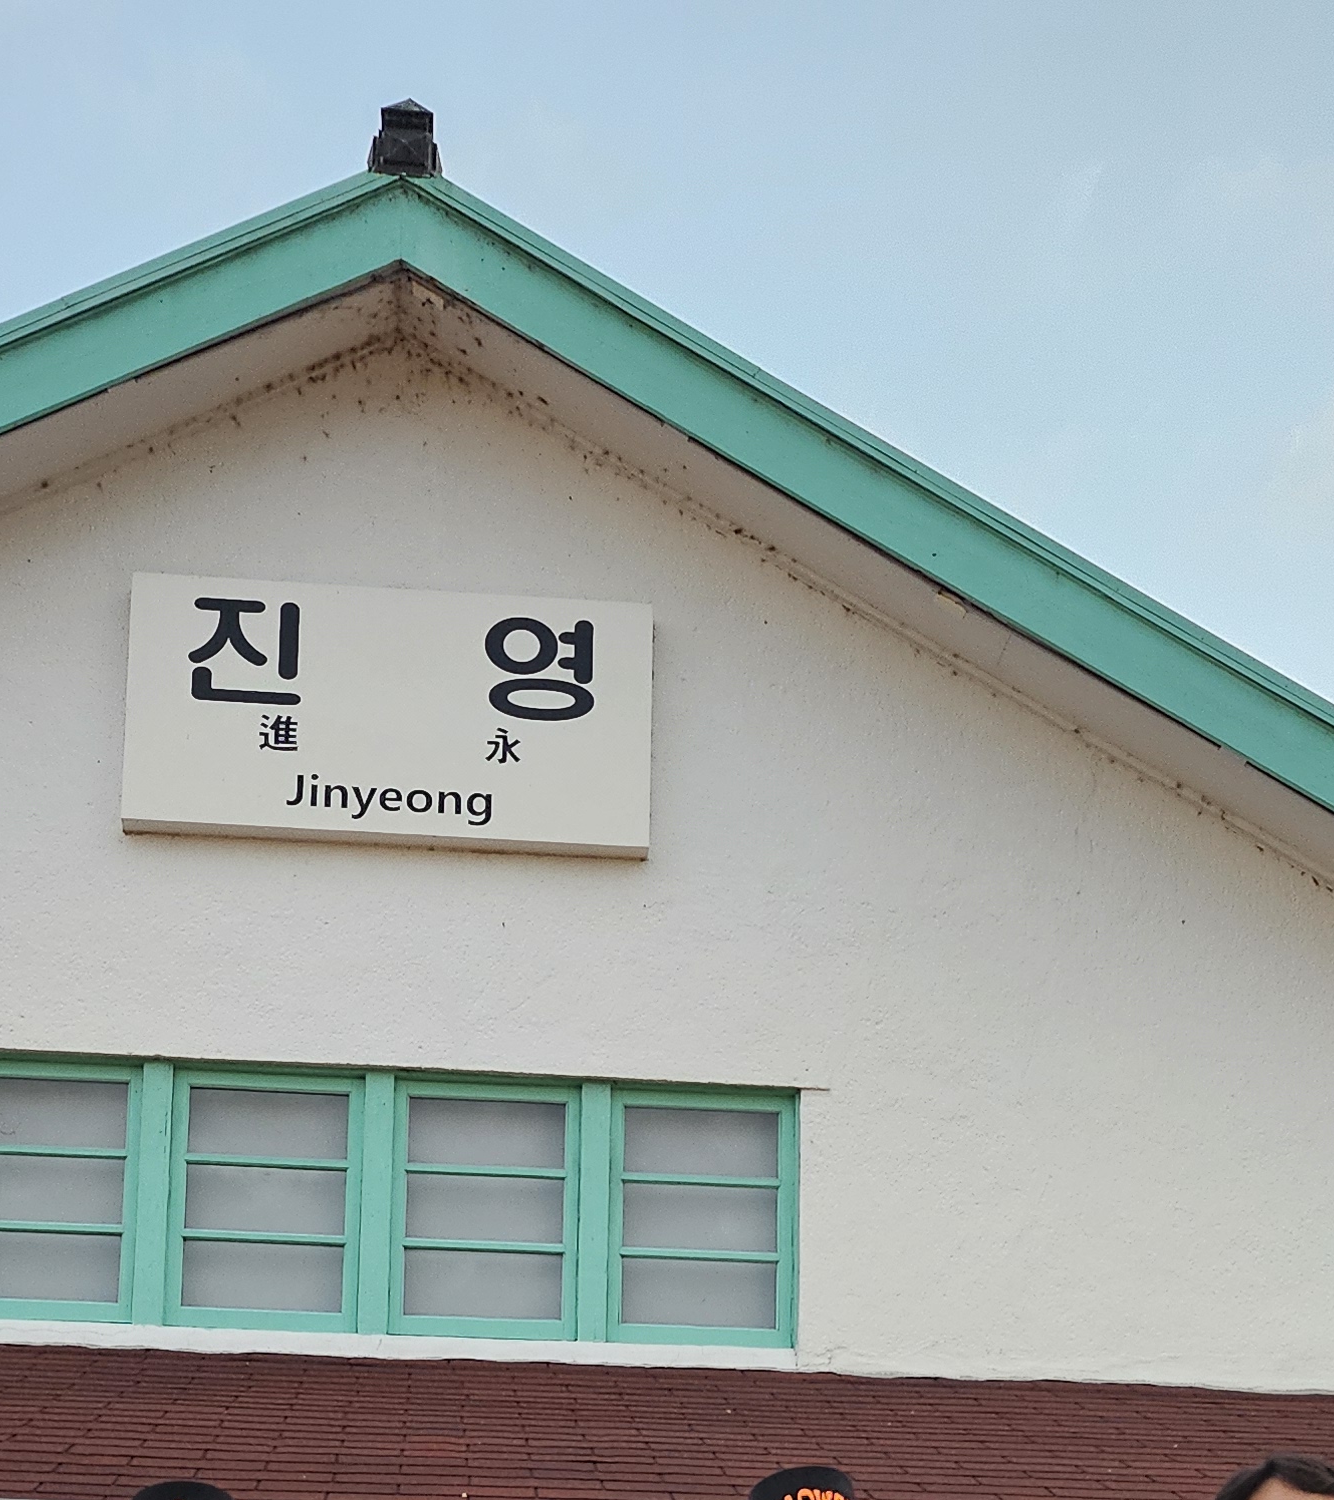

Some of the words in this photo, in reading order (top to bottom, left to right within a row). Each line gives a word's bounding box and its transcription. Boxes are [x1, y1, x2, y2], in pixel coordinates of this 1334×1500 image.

[187, 596, 302, 706] 진
[484, 616, 596, 722] 영
[258, 714, 300, 752] 進
[484, 727, 522, 765] 永
[286, 773, 494, 826] Jinyeong
